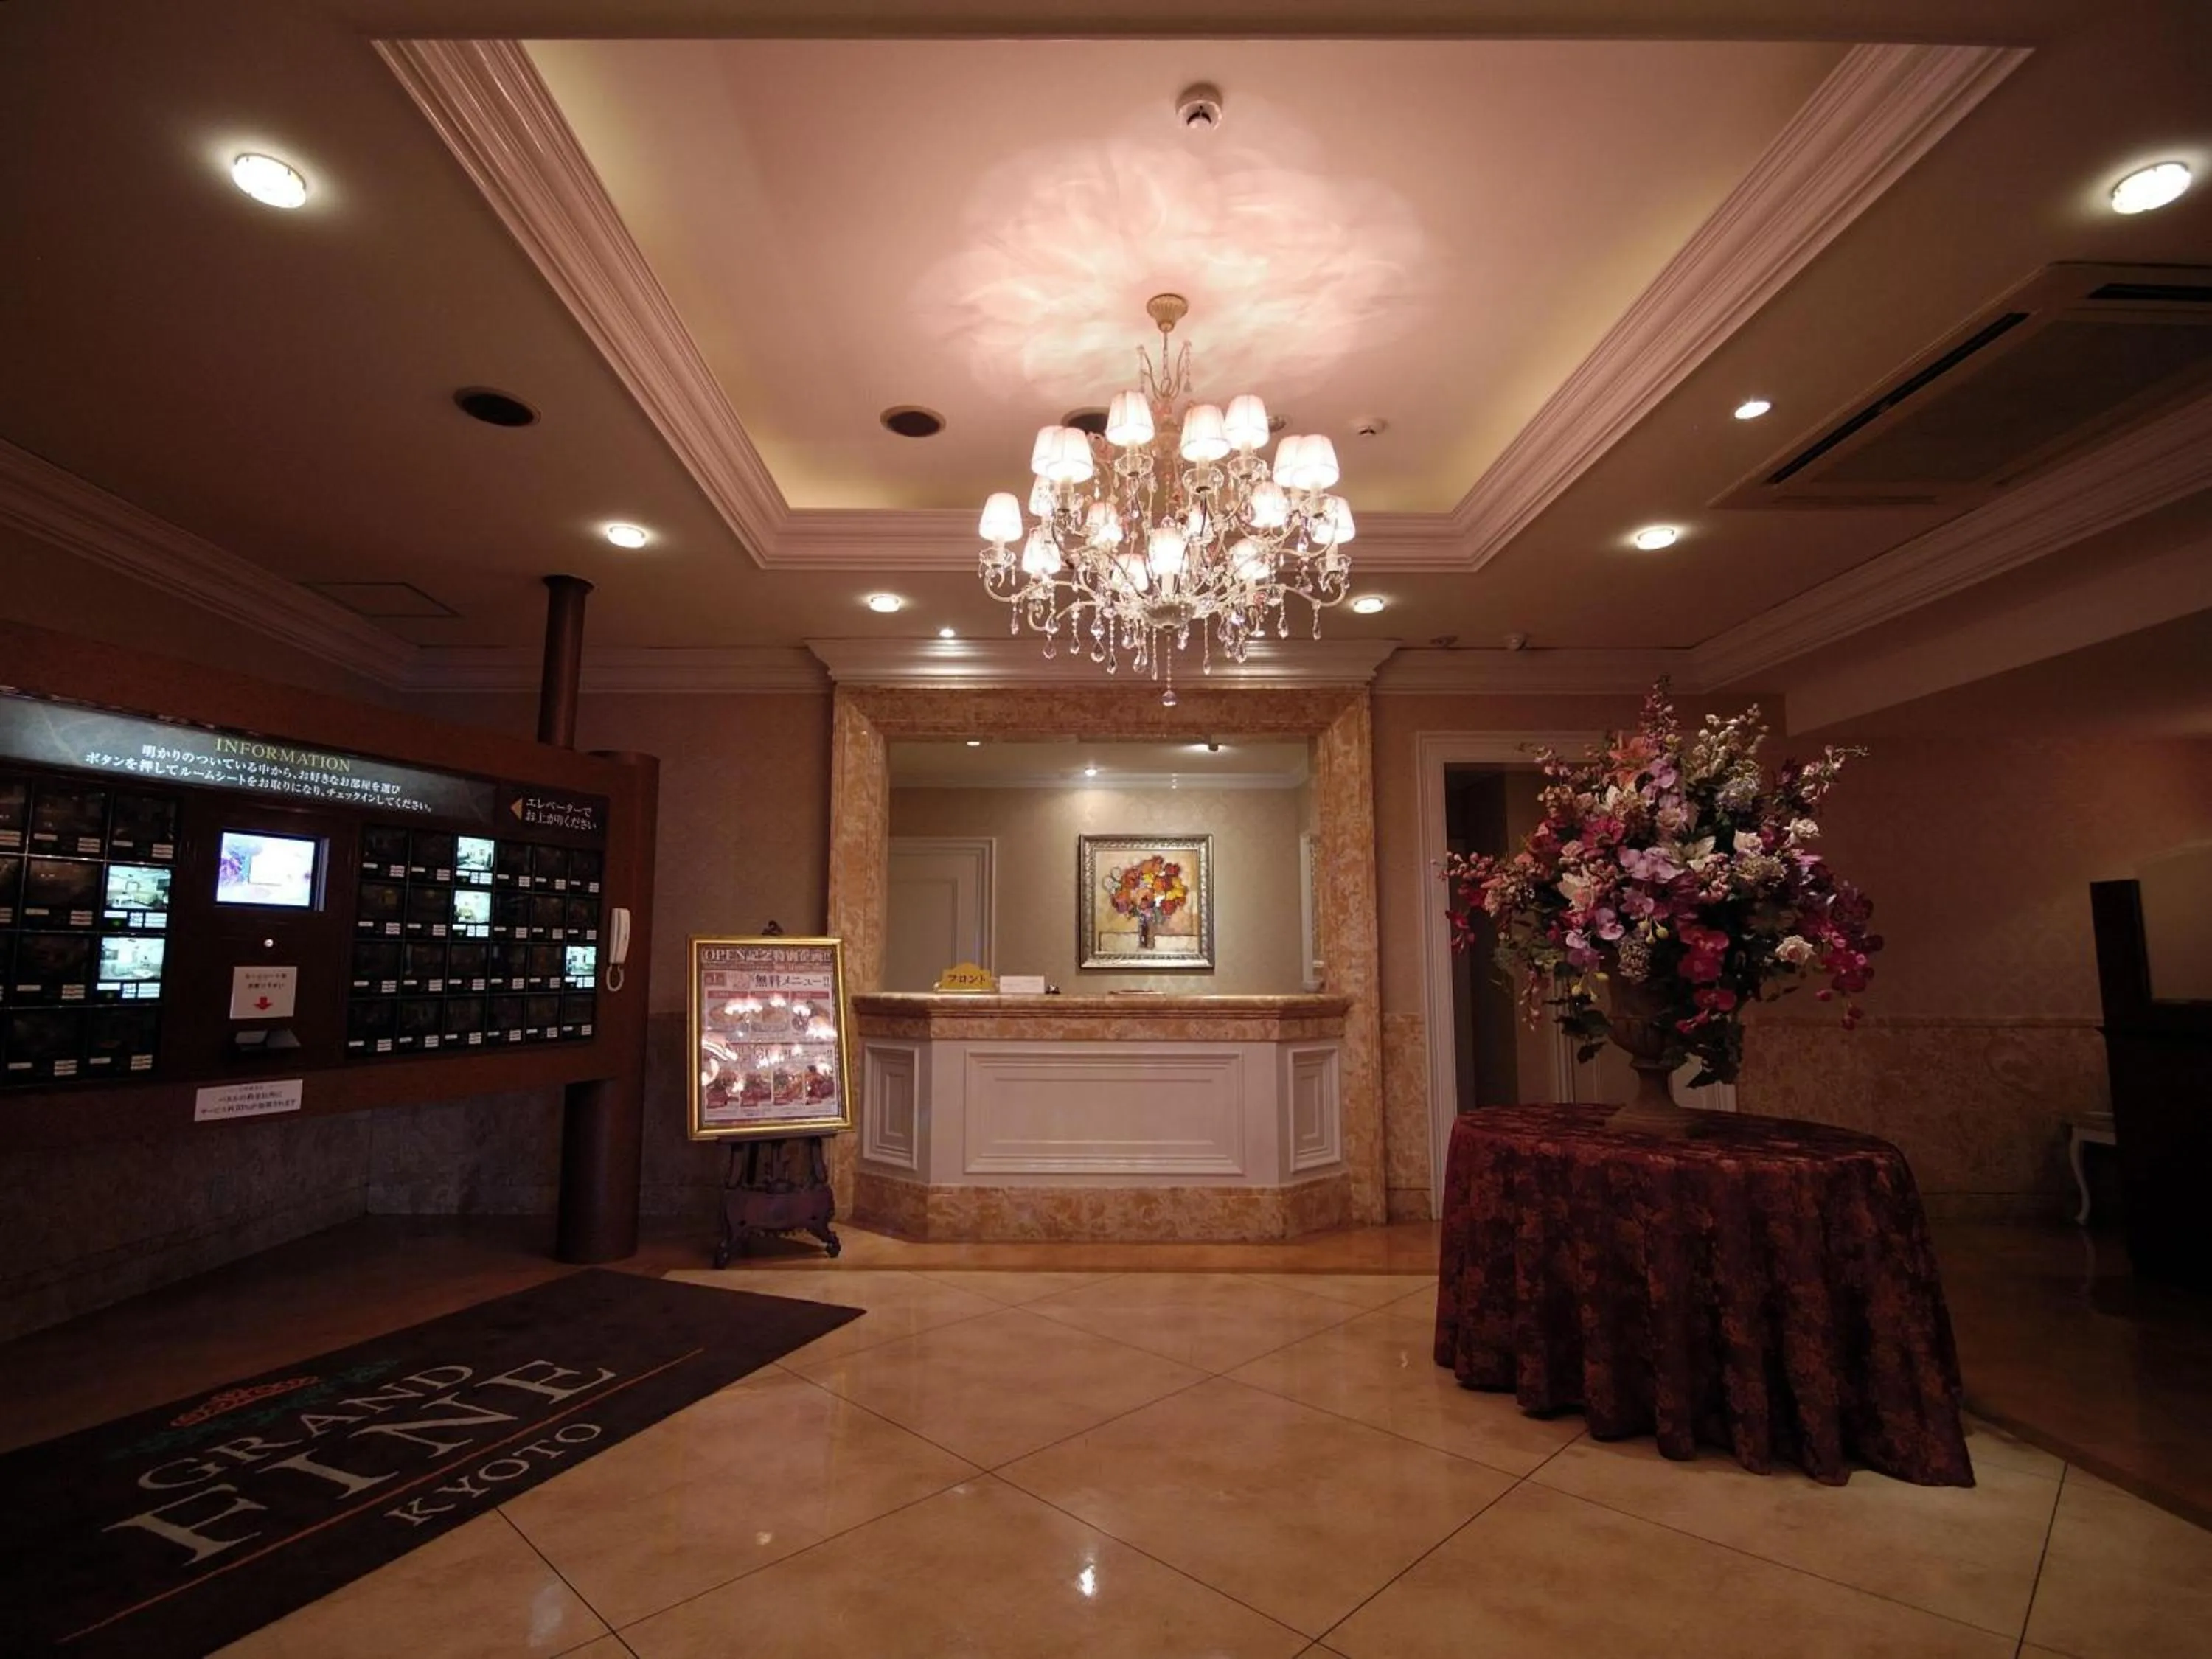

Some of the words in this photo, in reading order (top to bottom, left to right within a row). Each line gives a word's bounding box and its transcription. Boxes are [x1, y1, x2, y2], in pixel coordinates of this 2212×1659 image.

[216, 737, 351, 772] INFORMATION
[525, 810, 597, 830] お上がりください
[526, 798, 592, 818] エレベーターで
[947, 974, 986, 986] フロント
[137, 1365, 473, 1490] GRAND
[101, 1360, 616, 1566] FINE
[384, 1423, 602, 1526] KYOTO
